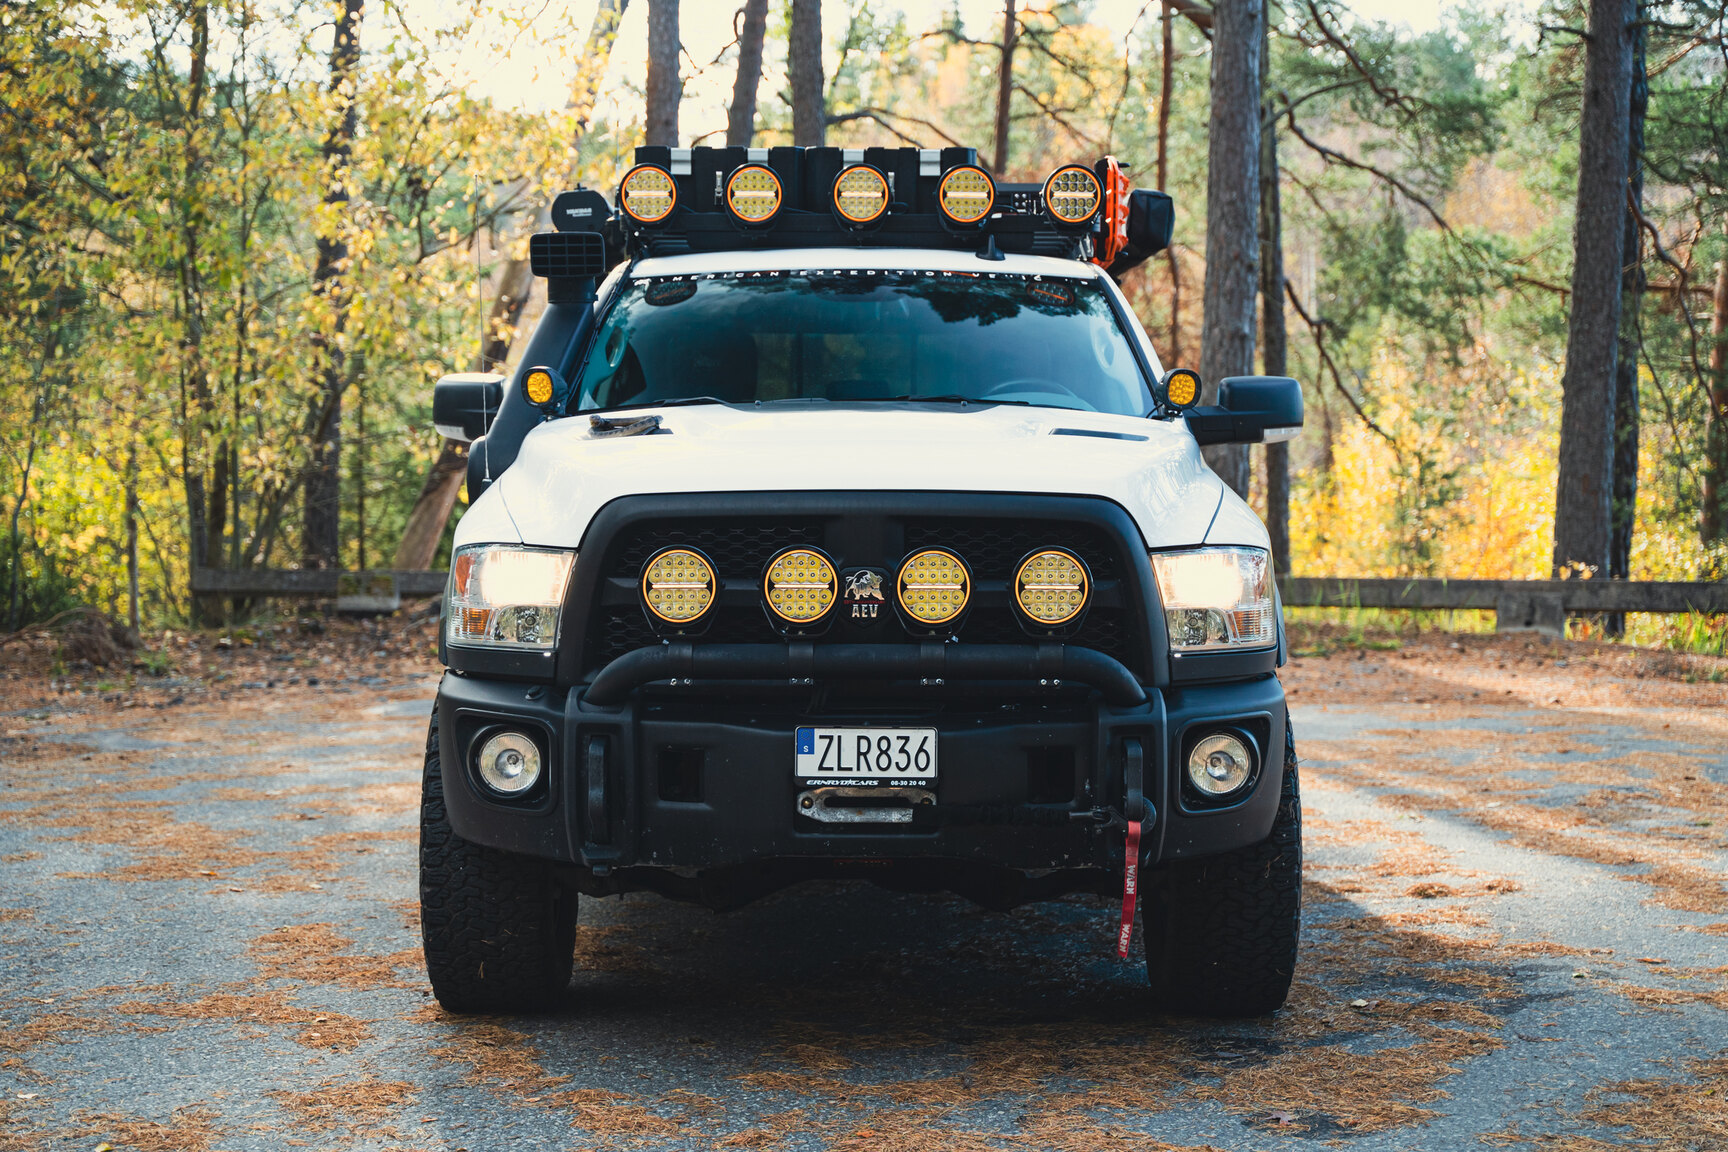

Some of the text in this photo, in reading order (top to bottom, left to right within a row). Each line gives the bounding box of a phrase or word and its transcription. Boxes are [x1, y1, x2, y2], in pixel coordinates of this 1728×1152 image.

[851, 603, 879, 618] AEV
[803, 745, 809, 753] S
[817, 734, 931, 773] ZLR836
[1126, 864, 1136, 895] WARN
[1119, 923, 1131, 953] WARN
